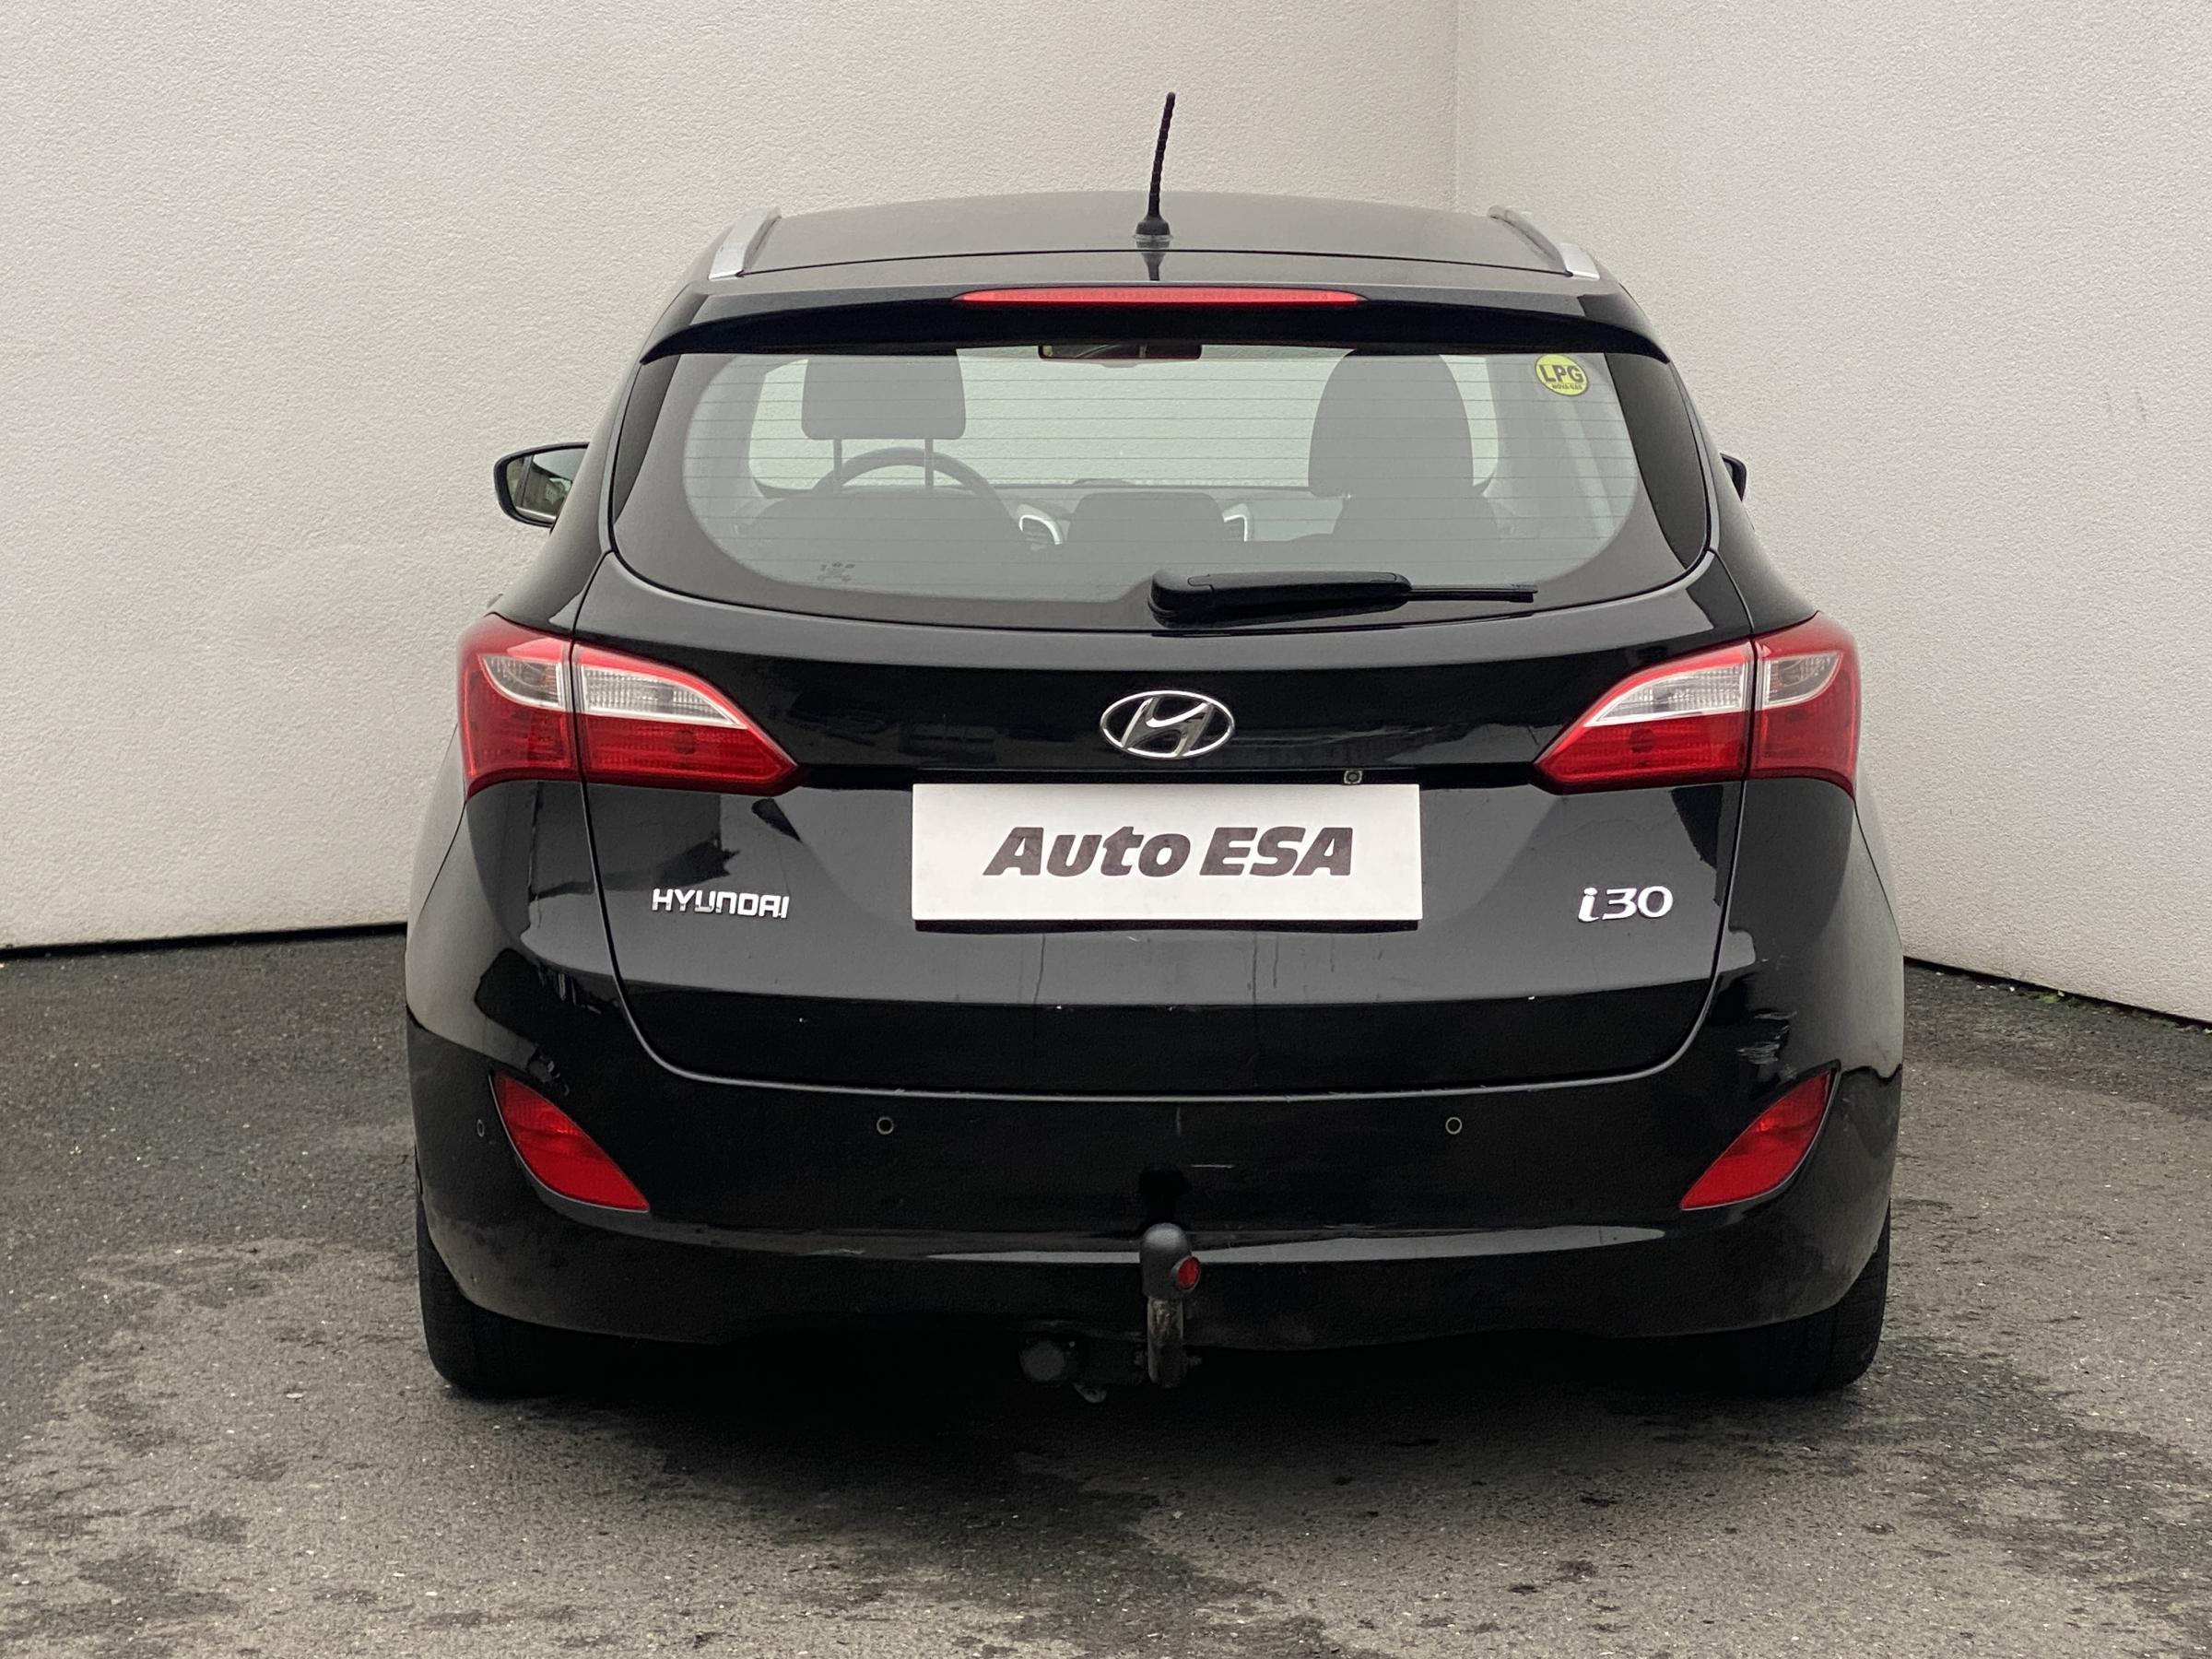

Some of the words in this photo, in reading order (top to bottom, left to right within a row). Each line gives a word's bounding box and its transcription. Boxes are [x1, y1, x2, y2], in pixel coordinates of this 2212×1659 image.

[1538, 364, 1584, 383] LPG
[982, 826, 1191, 877] Auto
[1199, 826, 1353, 877] ESA
[651, 888, 790, 919] HYUNDAI
[1578, 885, 1674, 923] i30
